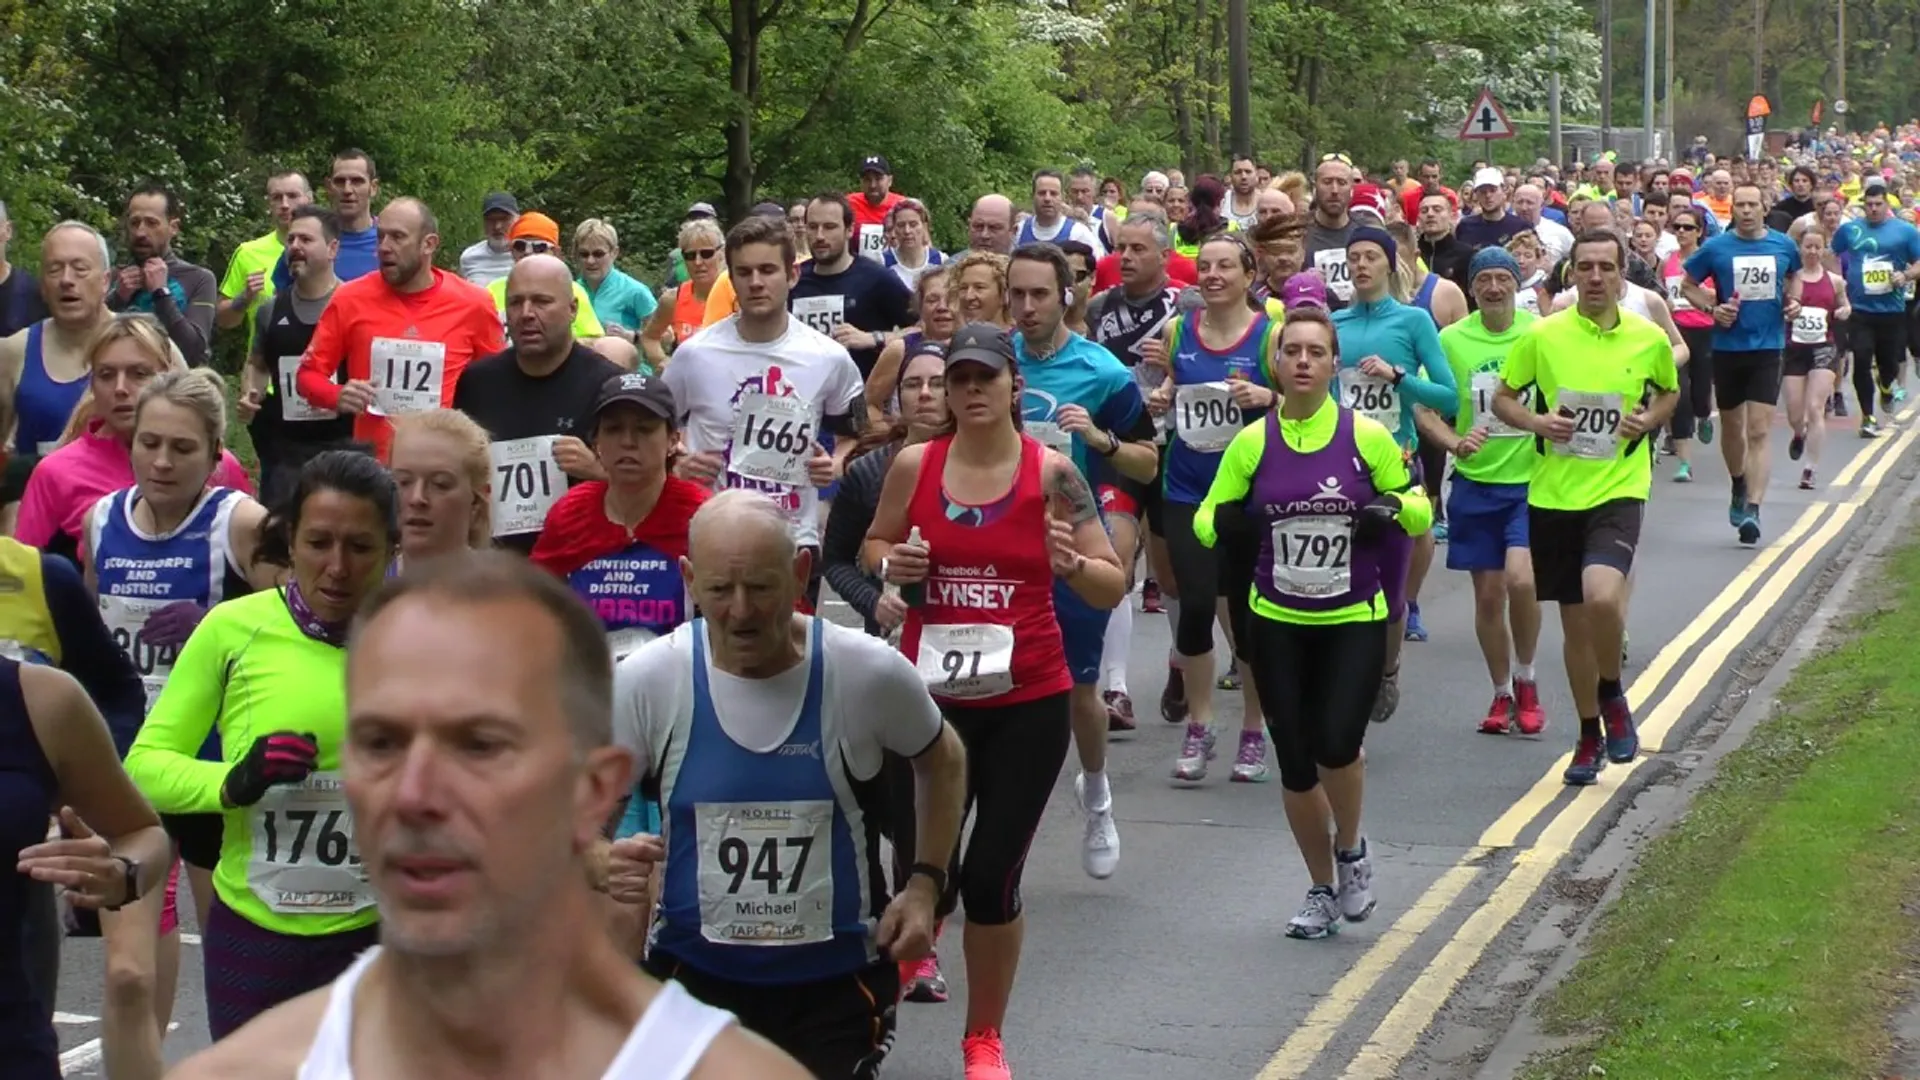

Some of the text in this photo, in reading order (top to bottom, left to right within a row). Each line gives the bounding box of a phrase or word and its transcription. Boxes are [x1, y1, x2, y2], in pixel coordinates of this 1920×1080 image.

[1741, 267, 1770, 285] 736
[799, 310, 842, 336] 555
[386, 358, 432, 392] 112
[1350, 384, 1392, 411] 266
[1184, 397, 1240, 430] 1906
[743, 413, 811, 455] 1665
[497, 460, 550, 502] 701
[1281, 532, 1348, 567] 1792
[126, 570, 157, 580] AND
[582, 559, 668, 571] CUNTHORPE
[603, 572, 635, 582] AND
[938, 564, 981, 576] Reebok
[110, 583, 172, 595] DISTRICT
[589, 583, 650, 595] DISTRICT
[926, 582, 1016, 609] LYNSEY
[942, 650, 982, 682] 91
[741, 809, 791, 818] NORTH
[718, 836, 814, 894] 947
[735, 901, 797, 915] Michael
